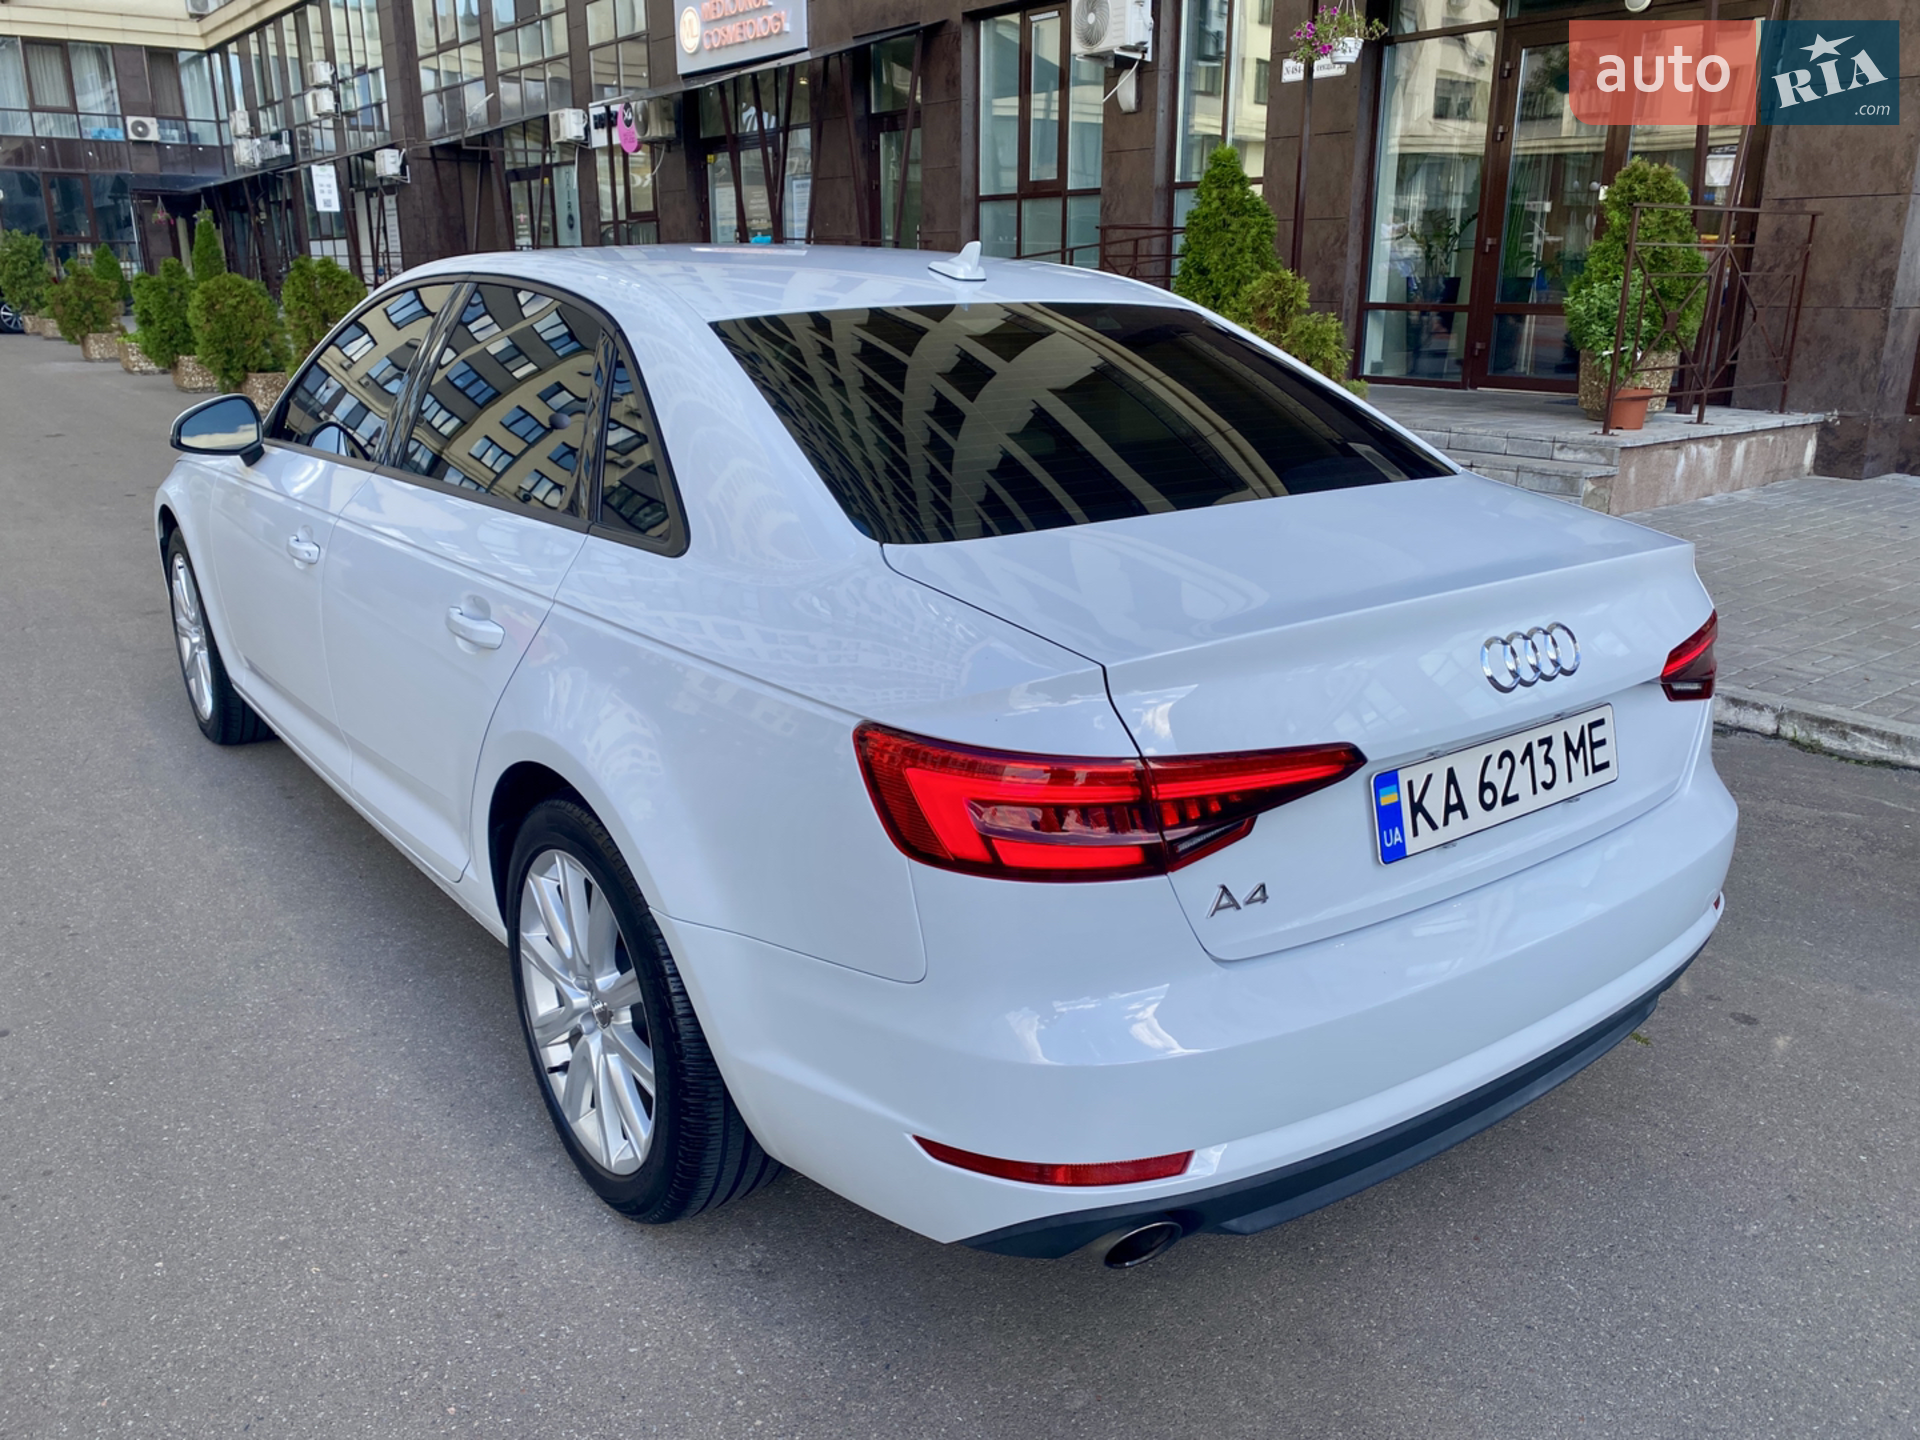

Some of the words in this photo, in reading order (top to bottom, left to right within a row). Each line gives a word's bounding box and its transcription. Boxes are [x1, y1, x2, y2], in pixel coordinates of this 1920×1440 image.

[703, 9, 788, 51] COSMETOLOGY
[1407, 766, 1469, 838] KA
[1478, 735, 1557, 812] 6213
[1563, 717, 1611, 784] ME
[1383, 826, 1403, 848] UA
[1206, 882, 1269, 919] A4
